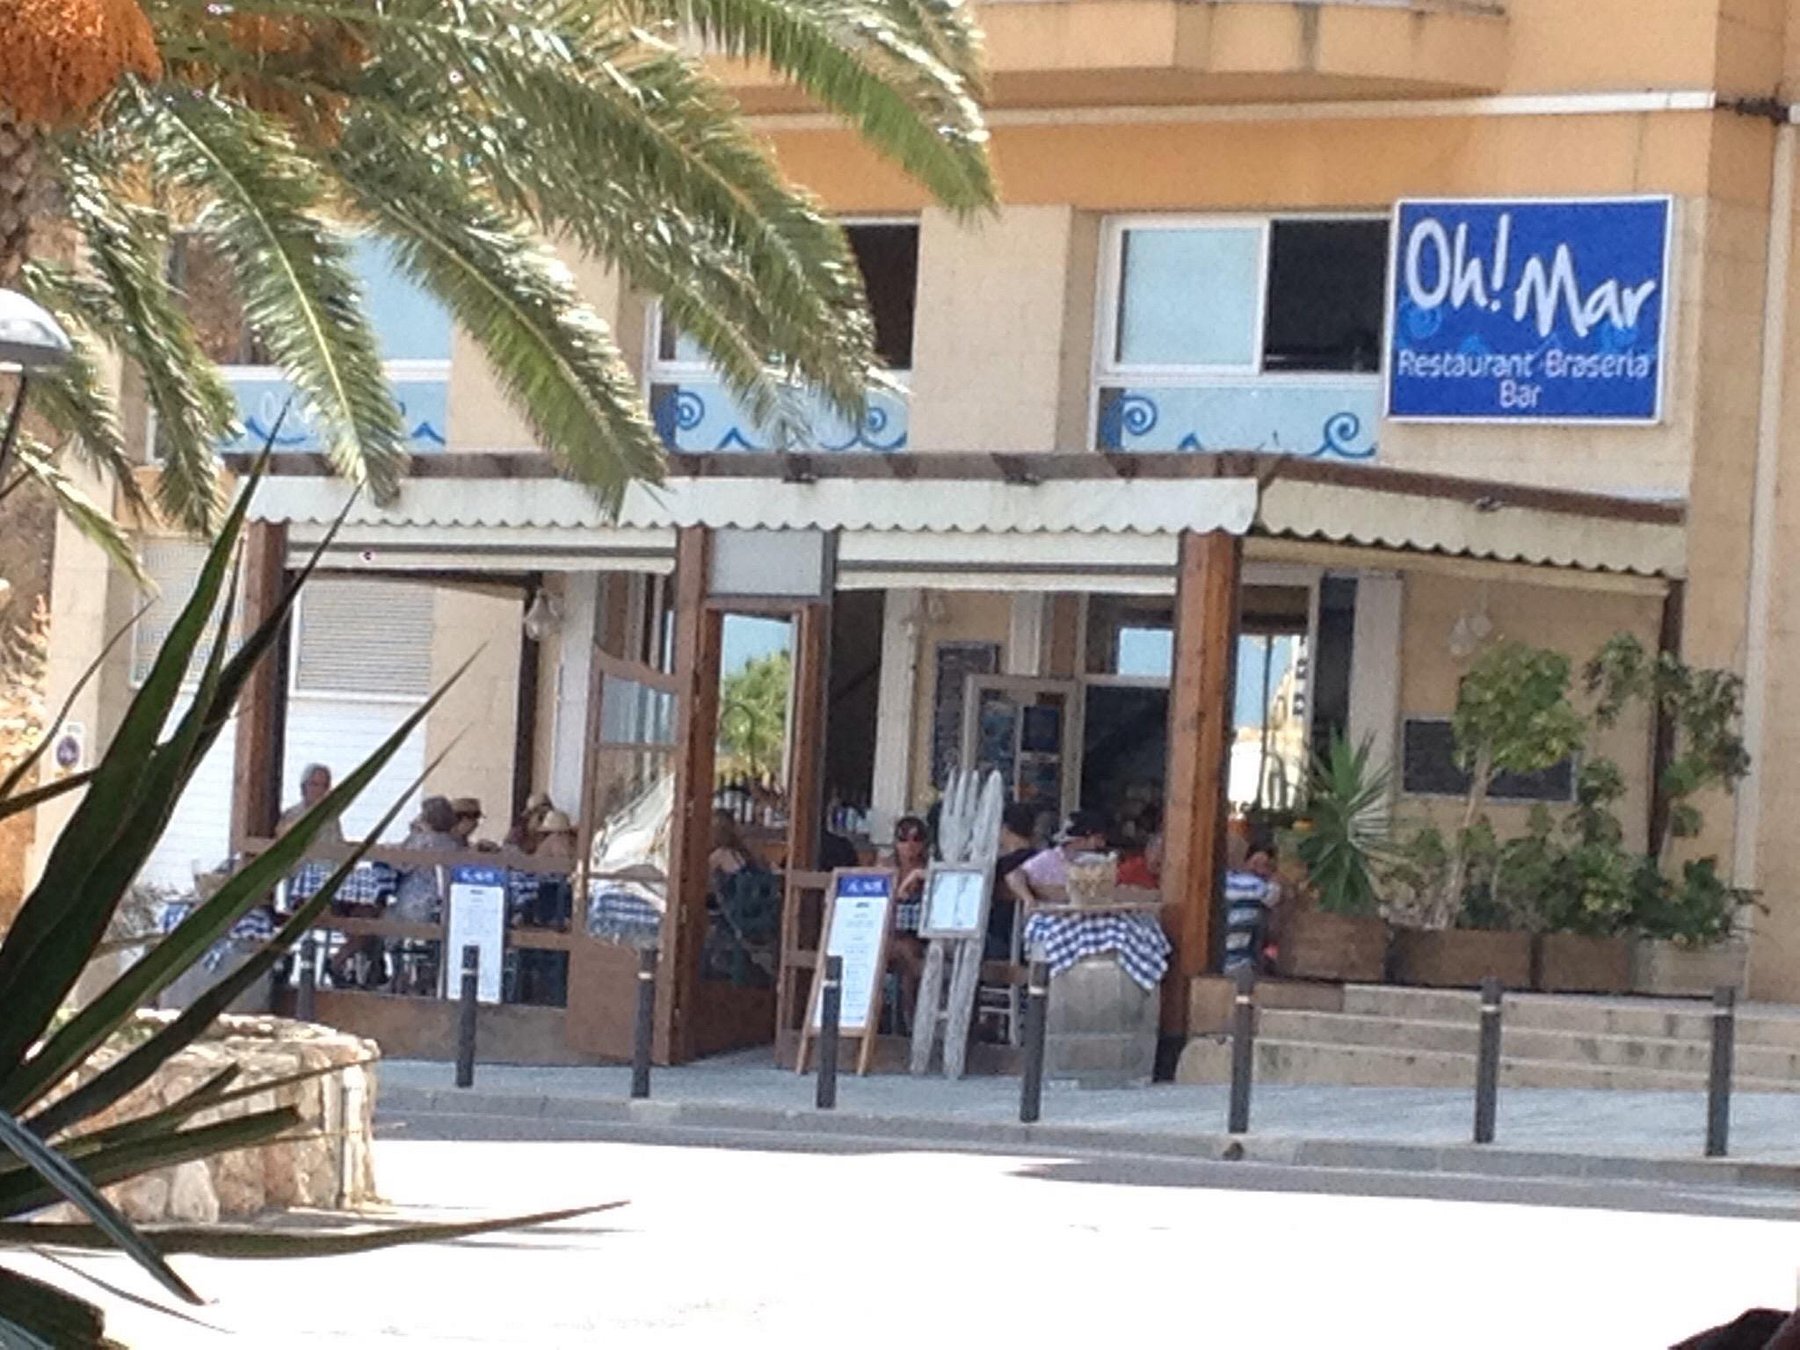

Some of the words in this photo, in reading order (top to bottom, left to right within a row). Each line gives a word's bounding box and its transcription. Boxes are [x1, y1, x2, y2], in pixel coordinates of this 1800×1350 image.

[1405, 213, 1509, 312] Oh!
[1513, 243, 1656, 338] Mar
[1398, 350, 1534, 378] Restaurant
[1500, 379, 1542, 409] Bar
